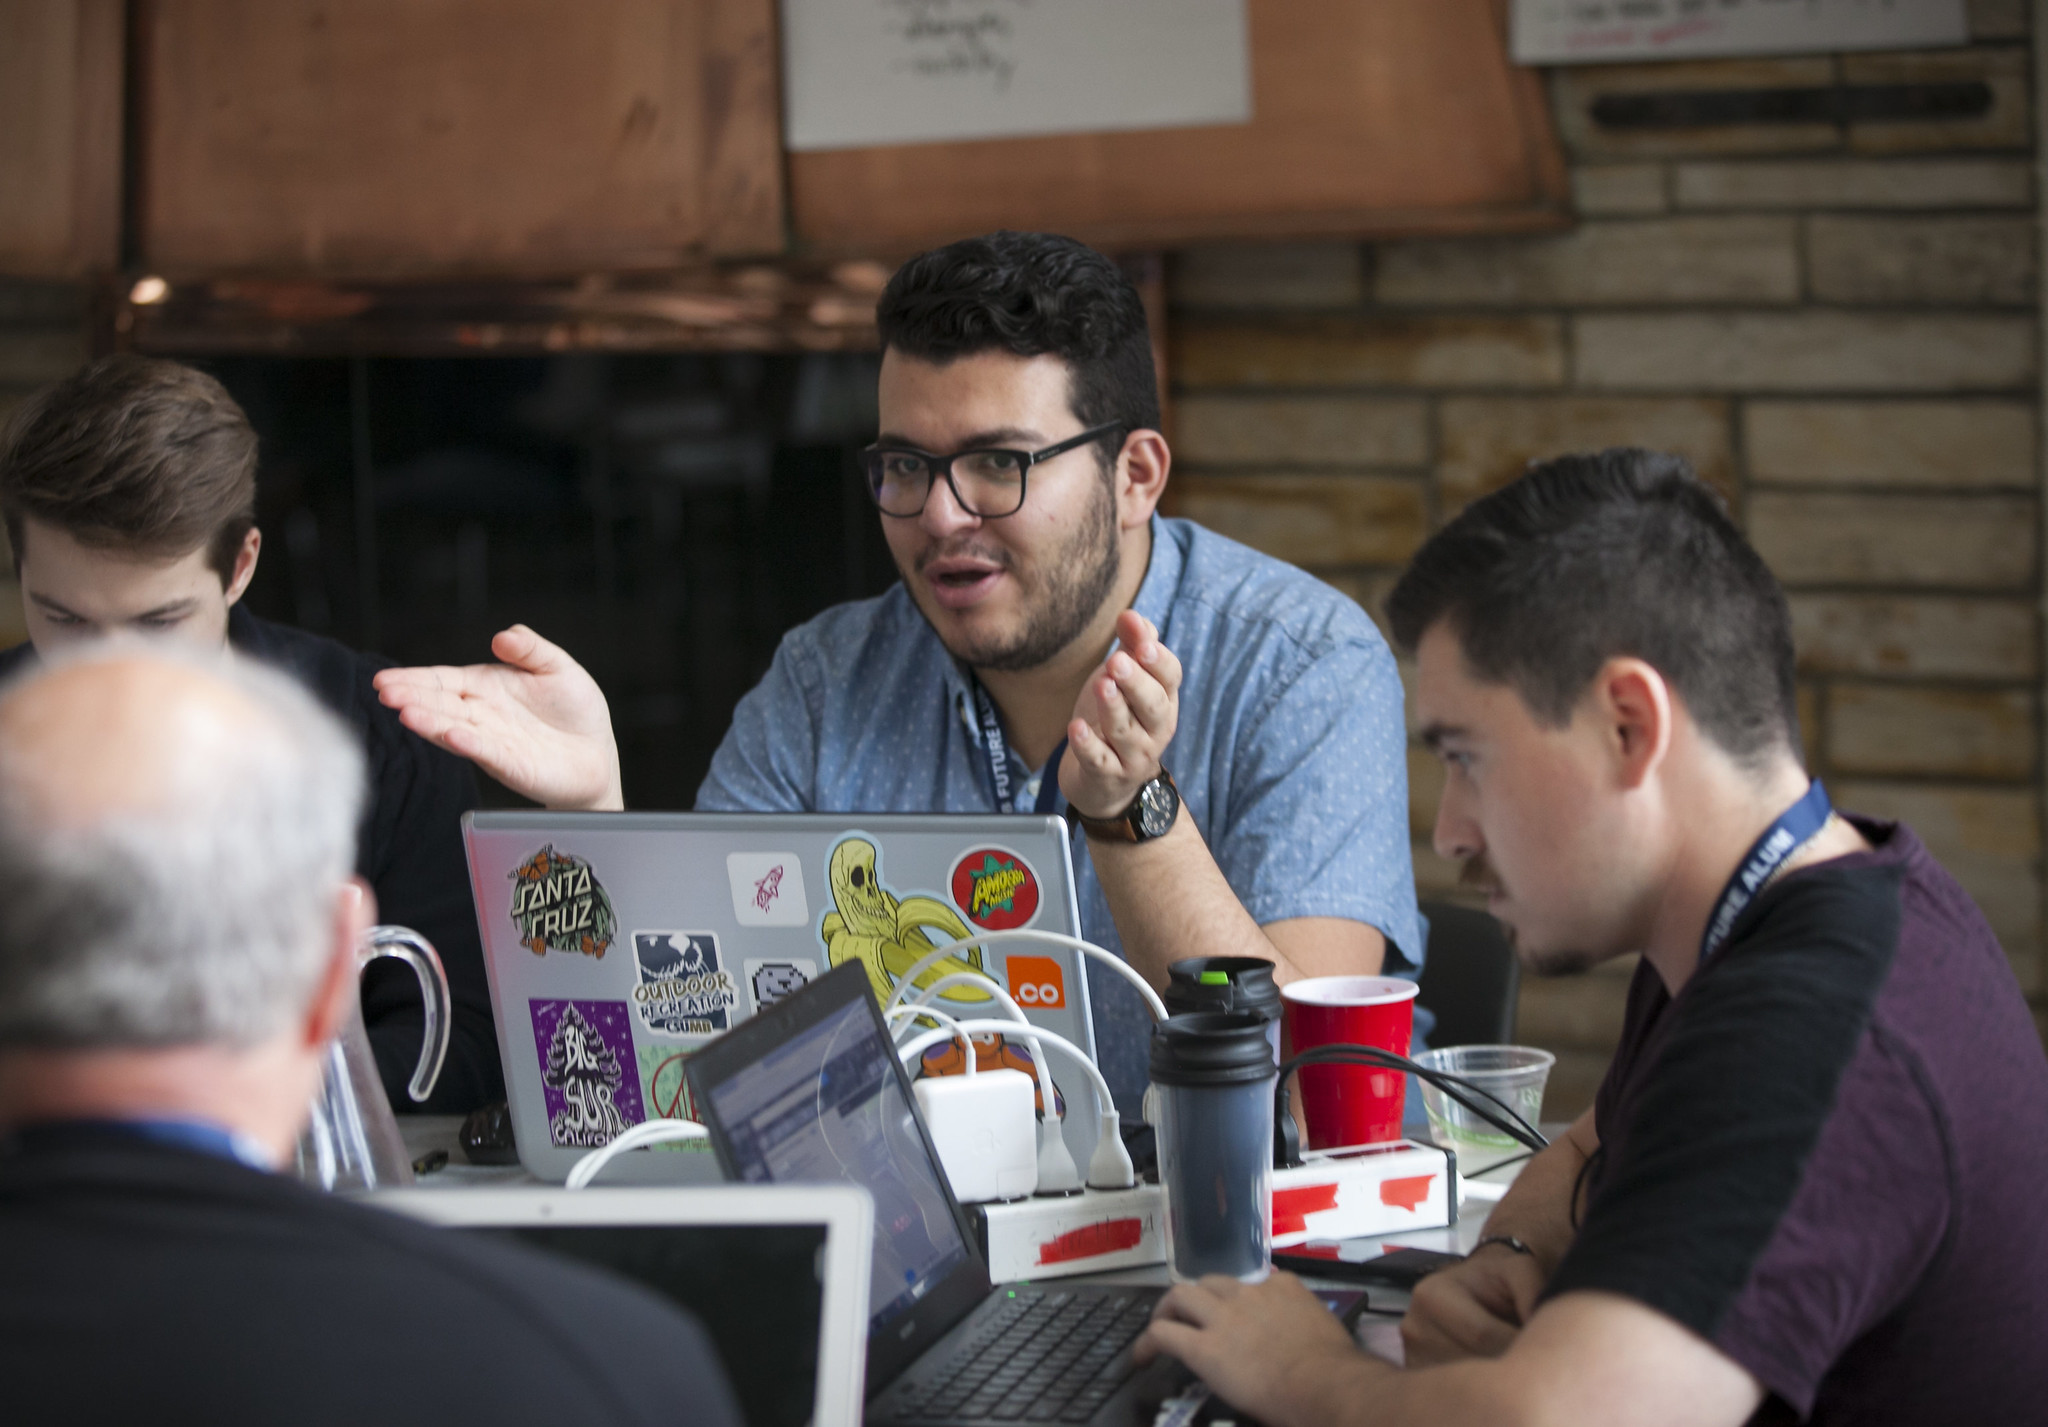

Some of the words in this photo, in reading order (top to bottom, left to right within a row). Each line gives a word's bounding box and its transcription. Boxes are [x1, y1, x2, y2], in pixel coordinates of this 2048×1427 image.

[985, 727, 1010, 798] FUTURE
[1741, 827, 1796, 893] ALUM
[511, 866, 592, 917] SANTA
[531, 898, 593, 940] CRUZ
[635, 973, 734, 1002] OUTDOOR
[641, 990, 734, 1021] RECREATION
[565, 1024, 600, 1077] BIG
[665, 1019, 712, 1034] CSUMB
[564, 1075, 630, 1134] SUR
